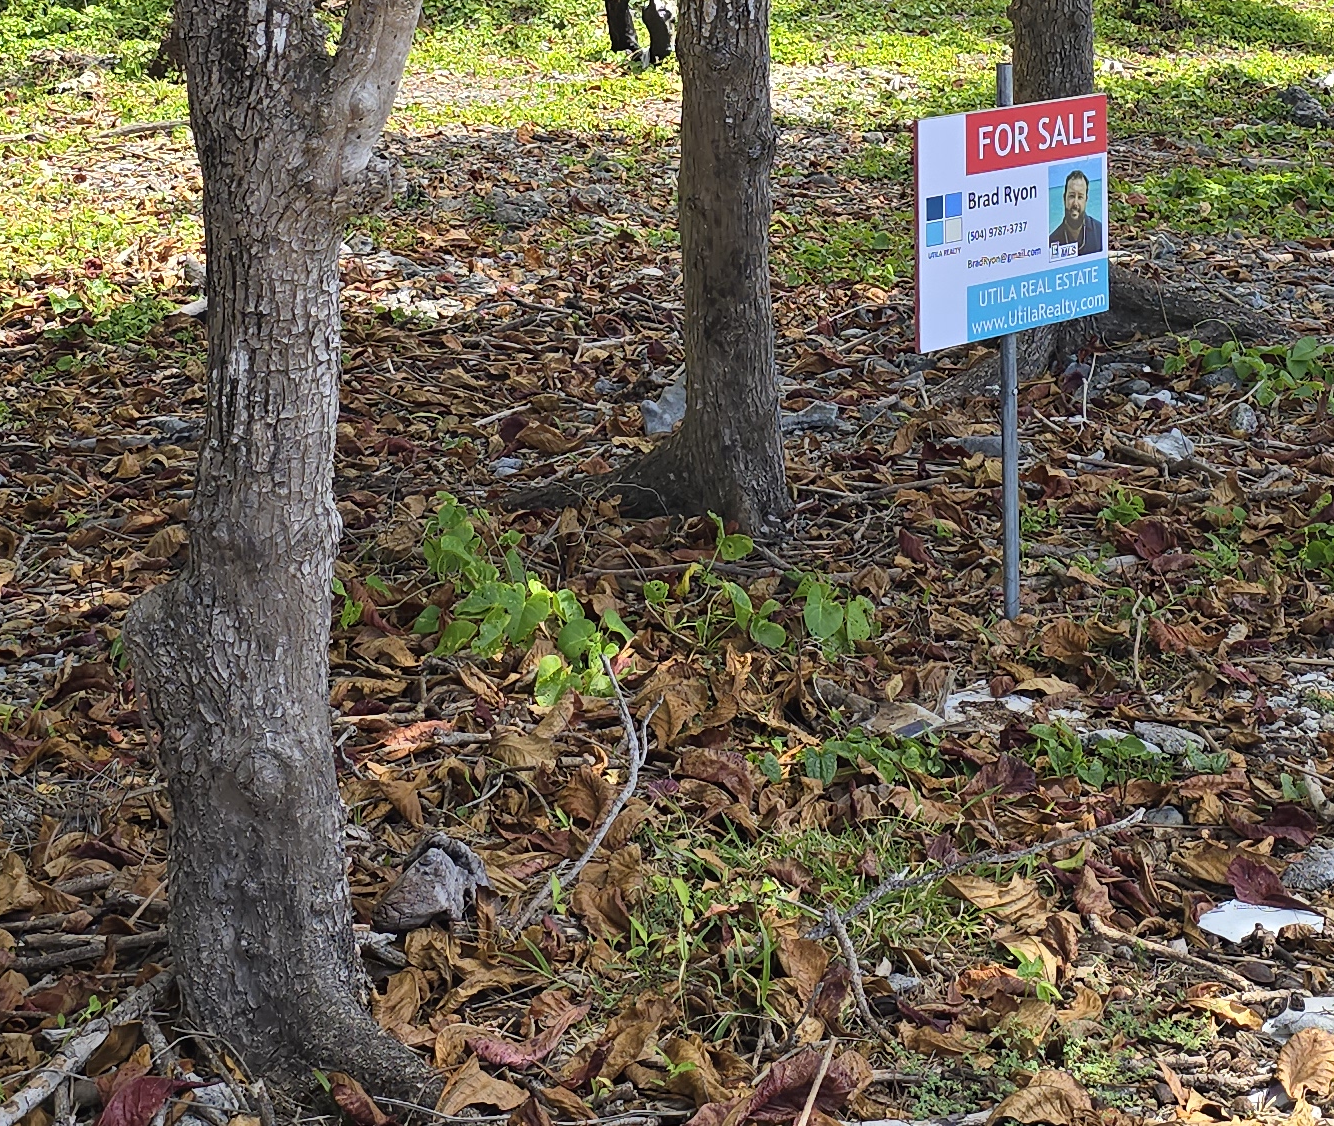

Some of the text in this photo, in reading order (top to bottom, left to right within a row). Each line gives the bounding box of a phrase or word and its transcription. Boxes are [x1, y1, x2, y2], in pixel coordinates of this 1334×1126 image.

[978, 110, 1097, 160] FOR SALE
[968, 184, 1038, 210] Brad Ryon
[967, 227, 987, 245] (504)
[979, 265, 1099, 308] UTILA REAL ESTATE
[971, 291, 1106, 336] www.UtilaRealty.com
